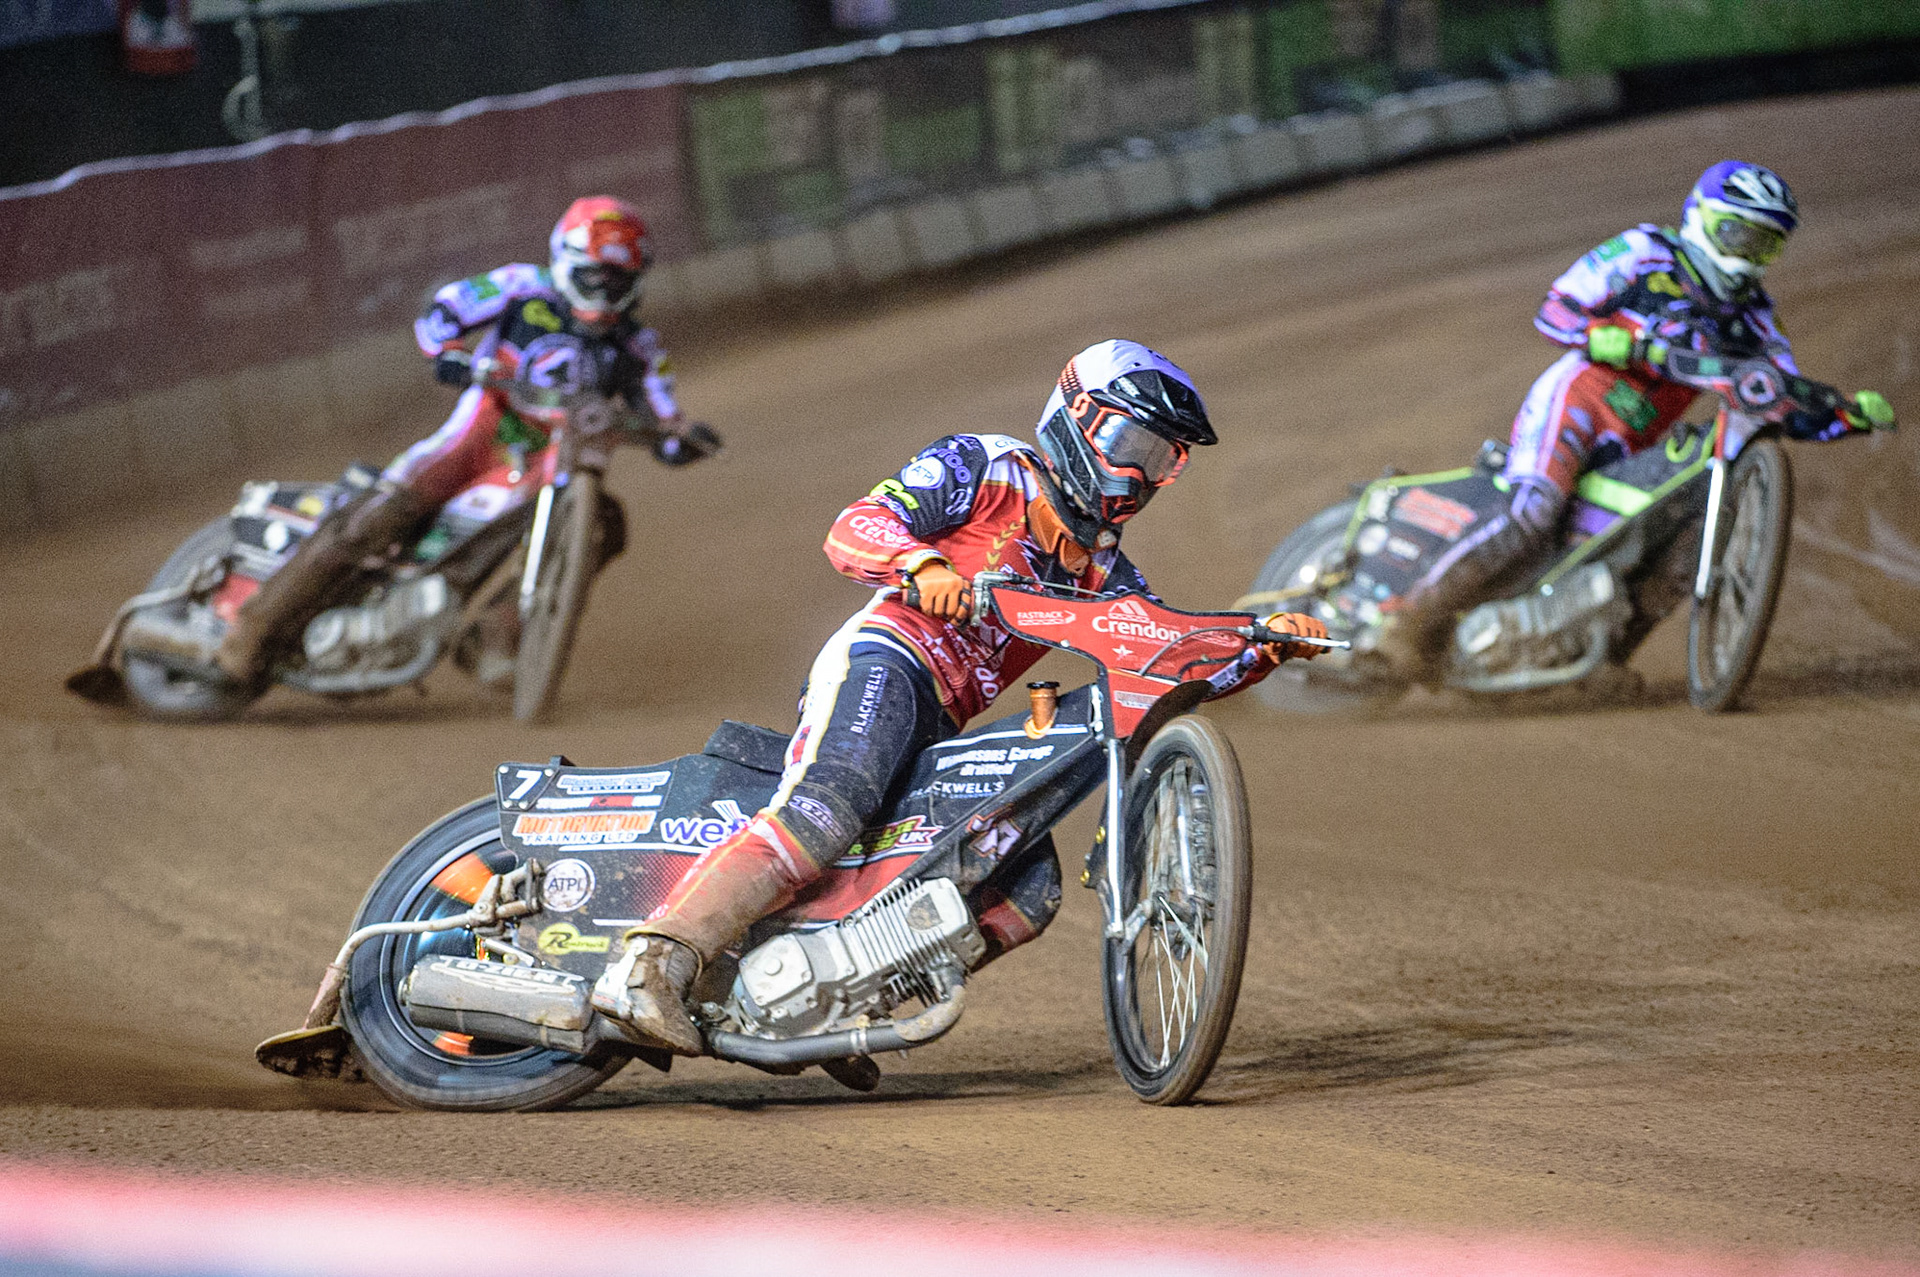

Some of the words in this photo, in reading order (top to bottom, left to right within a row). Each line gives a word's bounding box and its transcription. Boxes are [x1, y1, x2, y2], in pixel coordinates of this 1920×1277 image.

[911, 464, 935, 483] ATPI
[1017, 611, 1063, 620] FASTRACK
[1092, 616, 1182, 642] Crendon
[851, 666, 884, 734] BLACKWELL'S
[508, 769, 542, 800] 7
[517, 814, 653, 834] MOTORVATION
[525, 835, 600, 843] TRAINING
[607, 832, 635, 841] LTD
[900, 831, 929, 843] UK
[547, 877, 580, 891] ATPI
